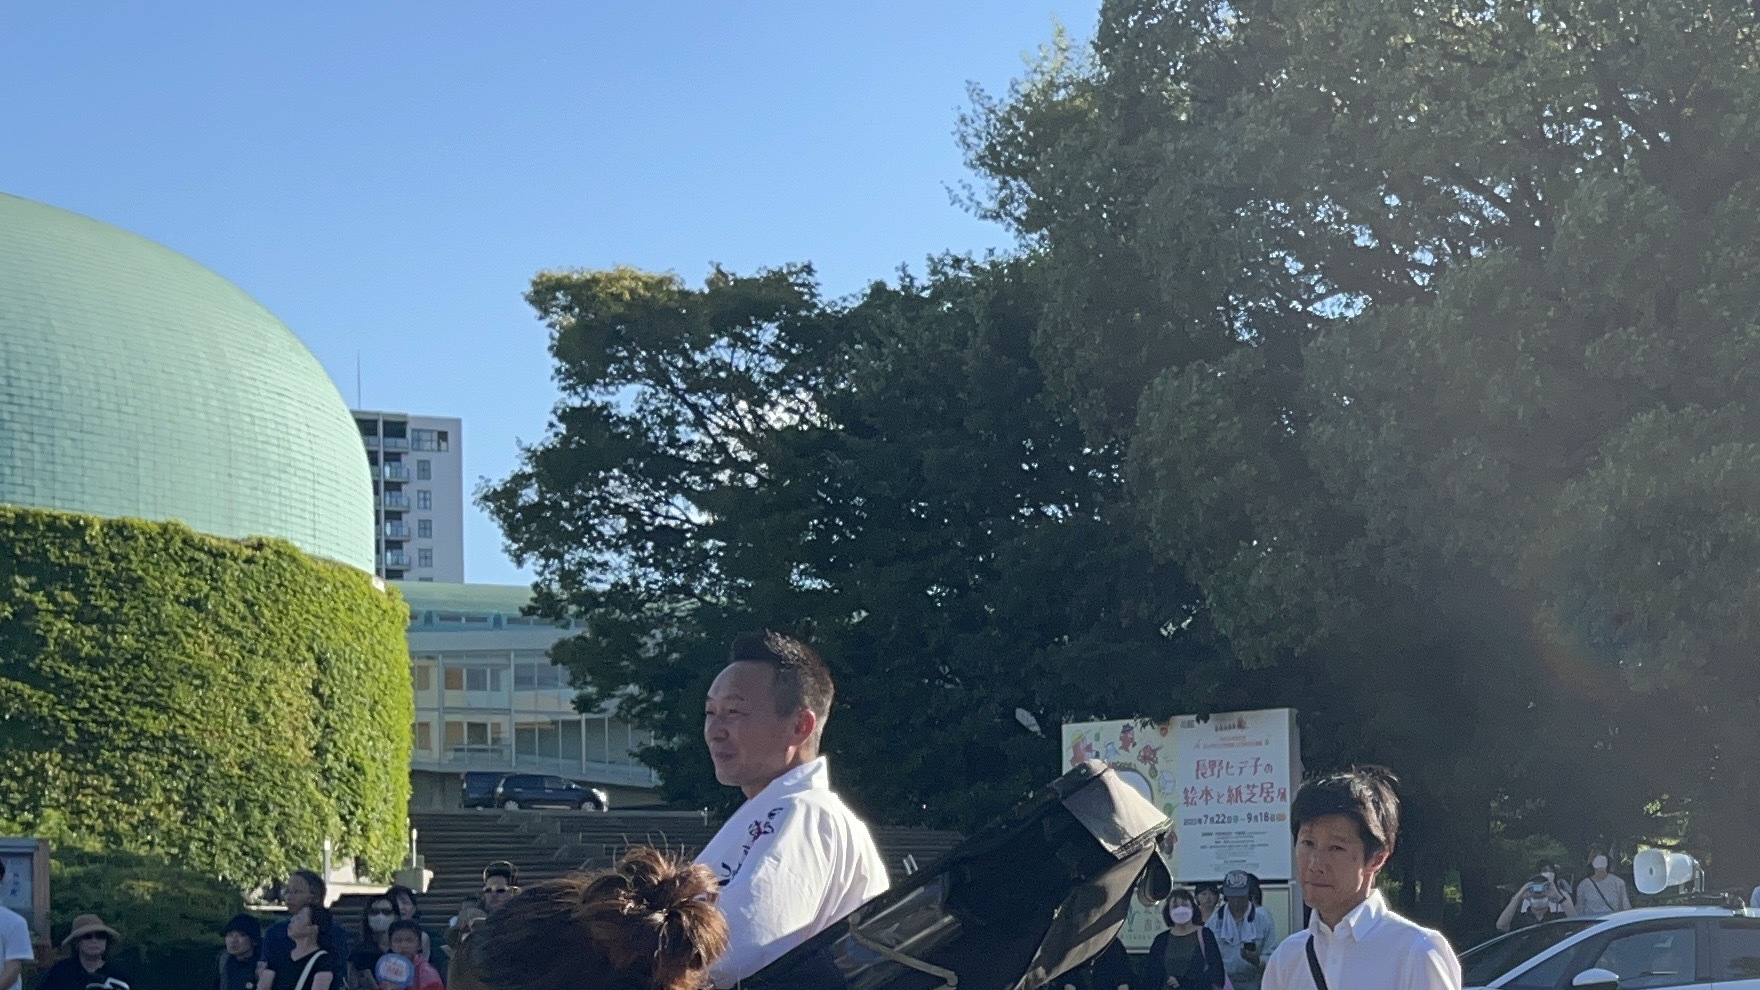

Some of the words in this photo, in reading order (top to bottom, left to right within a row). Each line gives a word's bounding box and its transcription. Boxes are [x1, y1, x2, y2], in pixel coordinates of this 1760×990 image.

[1195, 756, 1274, 780] 長野ヒデ子の
[1182, 781, 1288, 808] 絵本と紙芝居展
